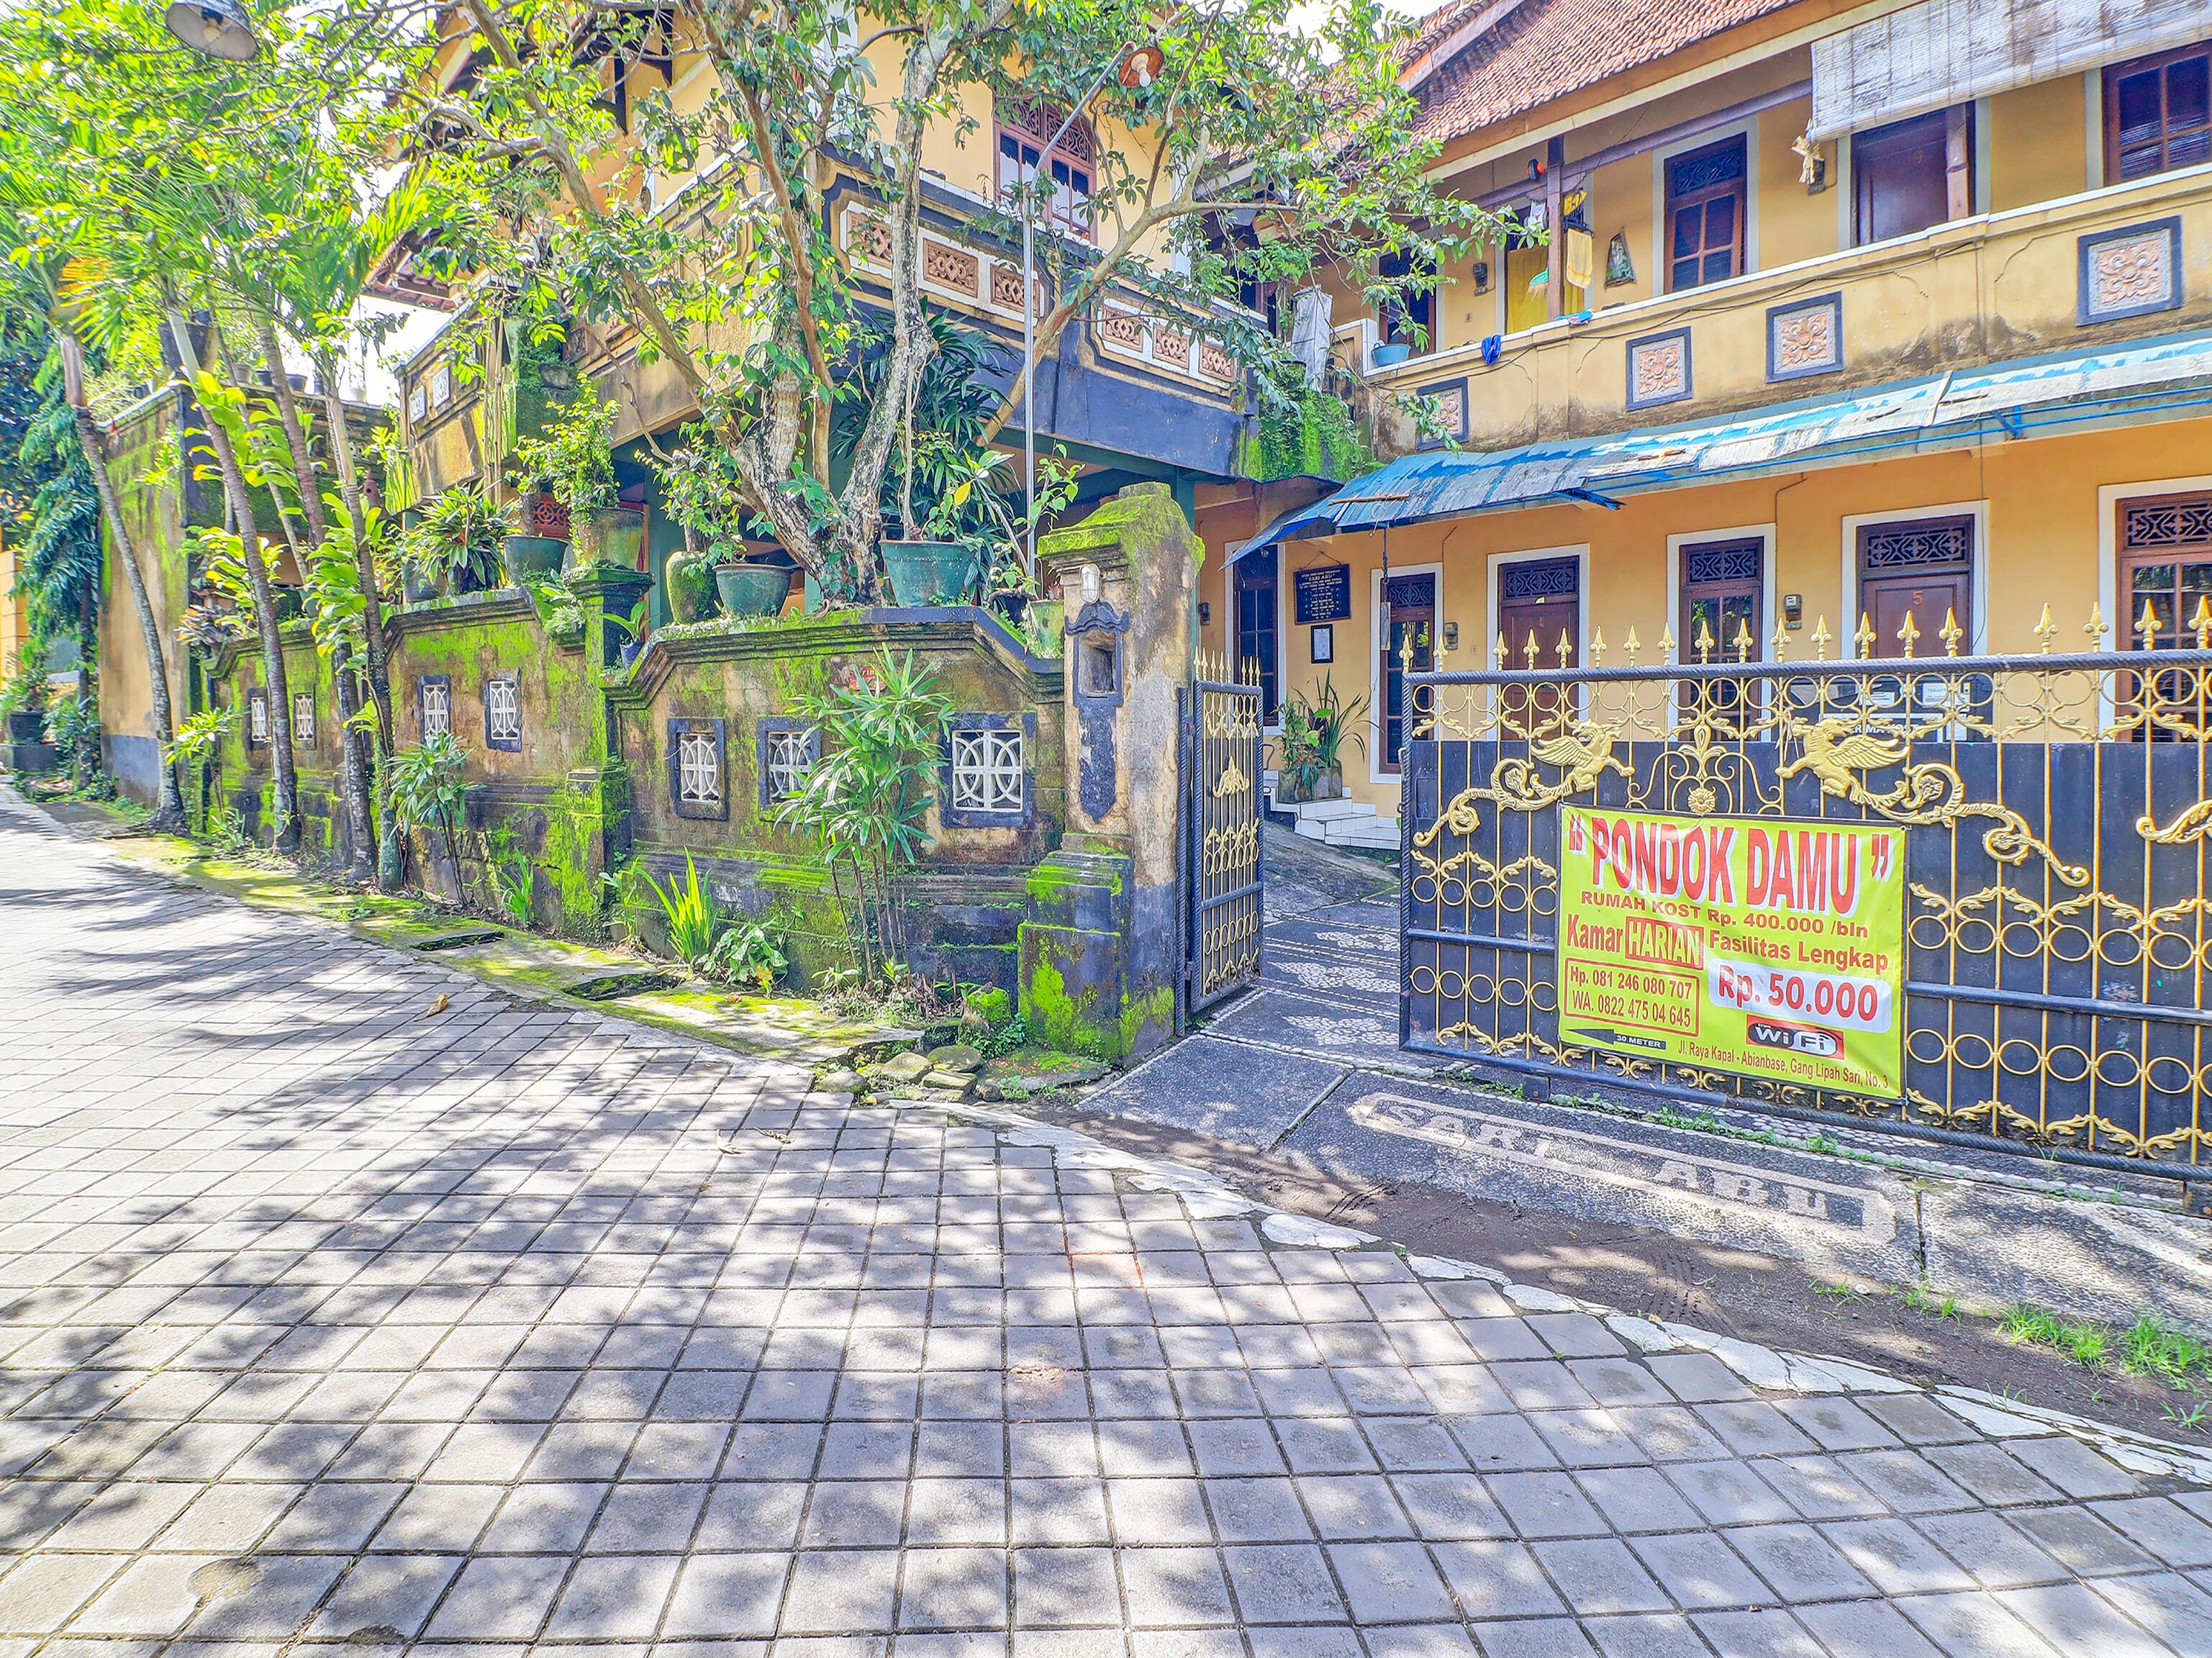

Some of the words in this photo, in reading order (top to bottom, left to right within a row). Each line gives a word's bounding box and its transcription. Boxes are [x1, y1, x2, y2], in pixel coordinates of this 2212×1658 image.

[1913, 590, 1923, 606] 5
[1592, 817, 1735, 904] PONDOK
[1746, 828, 1858, 915] DAMU
[1582, 891, 1646, 911] RUMAH
[1652, 900, 1701, 919] KOST
[1708, 909, 1736, 927] Rp.
[1744, 912, 1824, 933] 400.000
[1831, 920, 1868, 938] /bln
[1567, 914, 1623, 953] Kamar
[1628, 920, 1700, 966] HARIAN
[1710, 930, 1791, 960] Fasilitas
[1798, 941, 1889, 974] Lengkap
[1570, 966, 1588, 987] Hp.
[1592, 969, 1613, 987] 081
[1618, 972, 1639, 992] 246
[1643, 977, 1665, 995] 080
[1669, 981, 1692, 1000] 707
[1718, 965, 1761, 1007] Rp.
[1768, 973, 1878, 1022] 50.000
[1572, 990, 1594, 1012] WA.
[1598, 995, 1625, 1017] 0822
[1628, 999, 1649, 1020] 475
[1652, 1002, 1666, 1023] 04
[1669, 1005, 1691, 1028] 645
[1629, 1037, 1662, 1048] METER
[1678, 1041, 1687, 1055] Jl.
[1690, 1042, 1709, 1060] Raya
[1711, 1046, 1734, 1064] Kapal
[1741, 1051, 1787, 1074] Abianbase,
[1790, 1058, 1813, 1079] Gang
[1816, 1063, 1840, 1081] Lipah
[1843, 1066, 1864, 1087] Sari,
[1865, 1071, 1880, 1087] No.
[1882, 1075, 1889, 1088] 3
